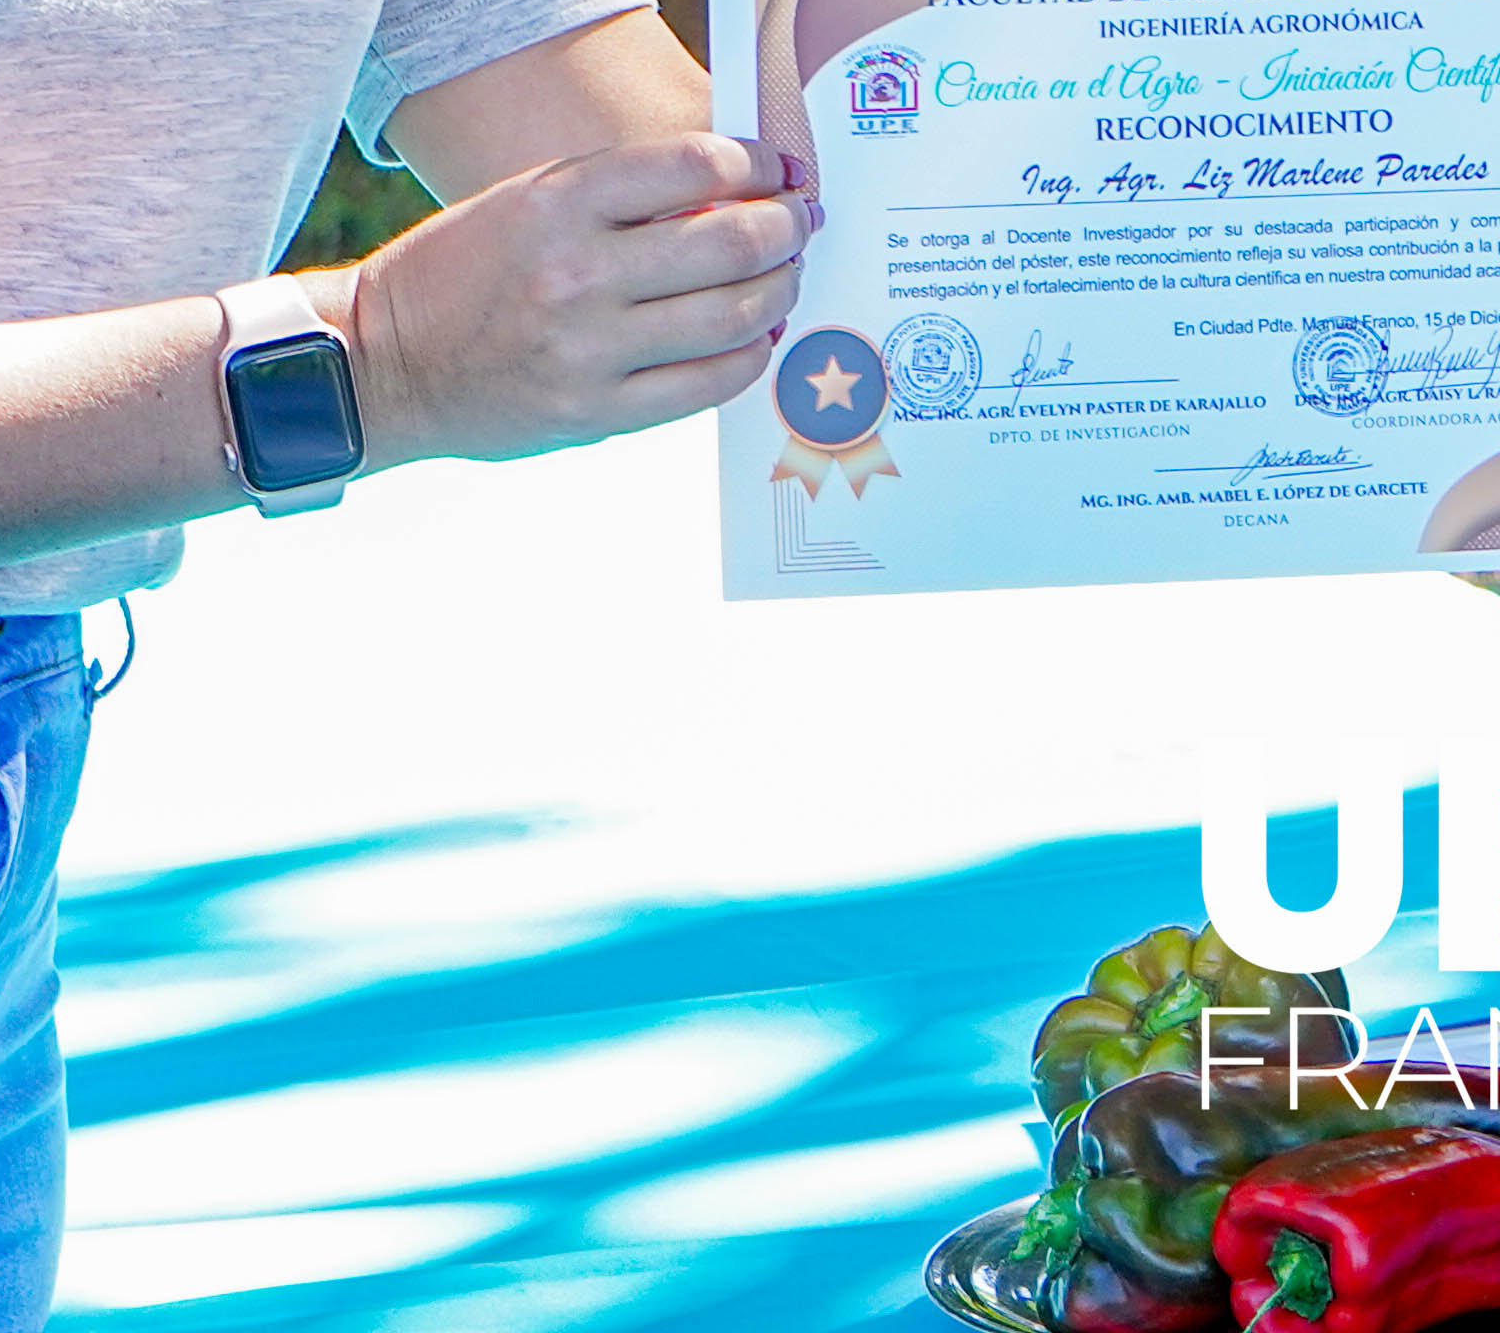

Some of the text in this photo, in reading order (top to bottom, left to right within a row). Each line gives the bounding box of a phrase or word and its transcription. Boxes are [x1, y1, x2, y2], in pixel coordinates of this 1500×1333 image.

[1100, 8, 1424, 38] INGENIERÍA AGRONÓMICA
[935, 61, 1039, 107] Ciencia
[1049, 82, 1078, 100] en
[1088, 64, 1115, 99] el
[1119, 55, 1201, 112] Agro
[1240, 47, 1396, 101] Iniciación
[1096, 109, 1393, 141] RECONOCIMIENTO
[1022, 153, 1489, 204] Ing. Agr. Liz Marlene Paredes
[888, 234, 908, 248] Se
[921, 233, 969, 250] otorga
[982, 230, 995, 245] al
[1007, 228, 1071, 244] Docente
[1084, 225, 1176, 242] Investigador
[1188, 226, 1213, 242] por
[1225, 225, 1242, 236] su
[1255, 220, 1332, 236] destacada
[1345, 215, 1438, 235] participación
[1450, 218, 1458, 231] y
[888, 257, 986, 276] presentación
[992, 255, 1015, 270] del
[1021, 253, 1073, 272] póster,
[1078, 254, 1110, 267] este
[1116, 248, 1232, 266] reconocimiento
[1237, 245, 1282, 263] refleja
[1288, 247, 1306, 259] su
[1311, 244, 1363, 259] valiosa
[1369, 239, 1458, 256] contribución
[1464, 242, 1473, 253] a
[1479, 238, 1492, 253] la
[889, 282, 988, 301] investigación
[992, 286, 1000, 299] y
[1006, 281, 1019, 294] el
[1023, 277, 1134, 294] fortalecimiento
[1139, 276, 1158, 291] de
[1162, 275, 1175, 289] la
[1180, 274, 1231, 289] cultura
[1236, 270, 1300, 286] científica
[1305, 273, 1324, 284] en
[1329, 270, 1385, 283] nuestra
[1389, 266, 1471, 282] comunidad
[1174, 322, 1195, 336] En
[1199, 320, 1254, 335] Ciudad
[1258, 319, 1297, 334] Pdte.
[1362, 314, 1419, 330] Franco,
[1425, 313, 1443, 327] 15
[1446, 312, 1466, 326] de
[978, 403, 1014, 419] AGR.
[1019, 401, 1081, 417] EVELYN
[1086, 400, 1146, 415] PASTER
[1150, 399, 1170, 413] DE
[1176, 395, 1266, 412] KARAJALLO
[1415, 387, 1464, 402] DAISY
[989, 423, 1191, 445] DPTO. DE INVESTIGACIÓN
[1352, 411, 1482, 429] COORDINADORA
[1081, 482, 1429, 510] MG. ING. AMB. MABEL E. LÓPEZ DE GARCETE
[1224, 514, 1289, 528] DECANA
